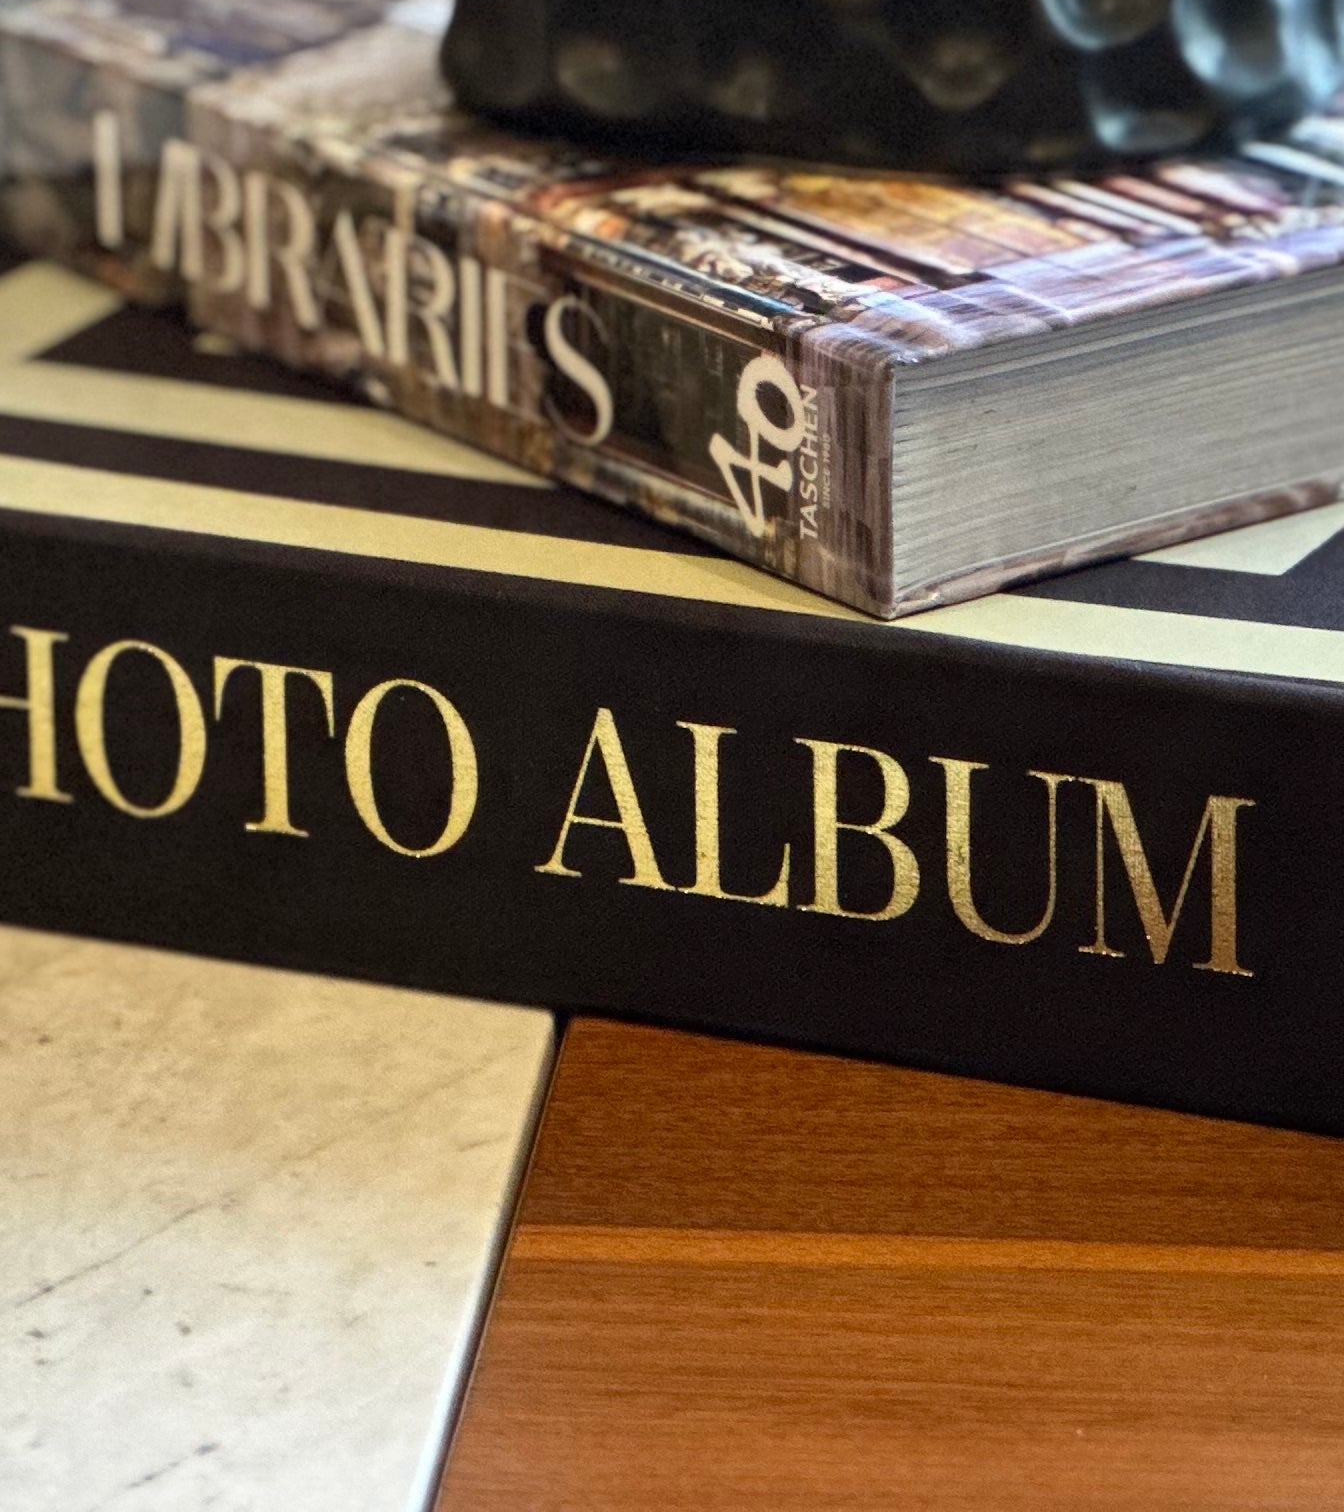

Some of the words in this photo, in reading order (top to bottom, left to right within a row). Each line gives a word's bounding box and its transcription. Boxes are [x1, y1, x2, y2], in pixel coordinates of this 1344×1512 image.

[709, 352, 804, 537] 40
[799, 383, 819, 539] TASCHEN
[534, 706, 1256, 978] ALBUM
